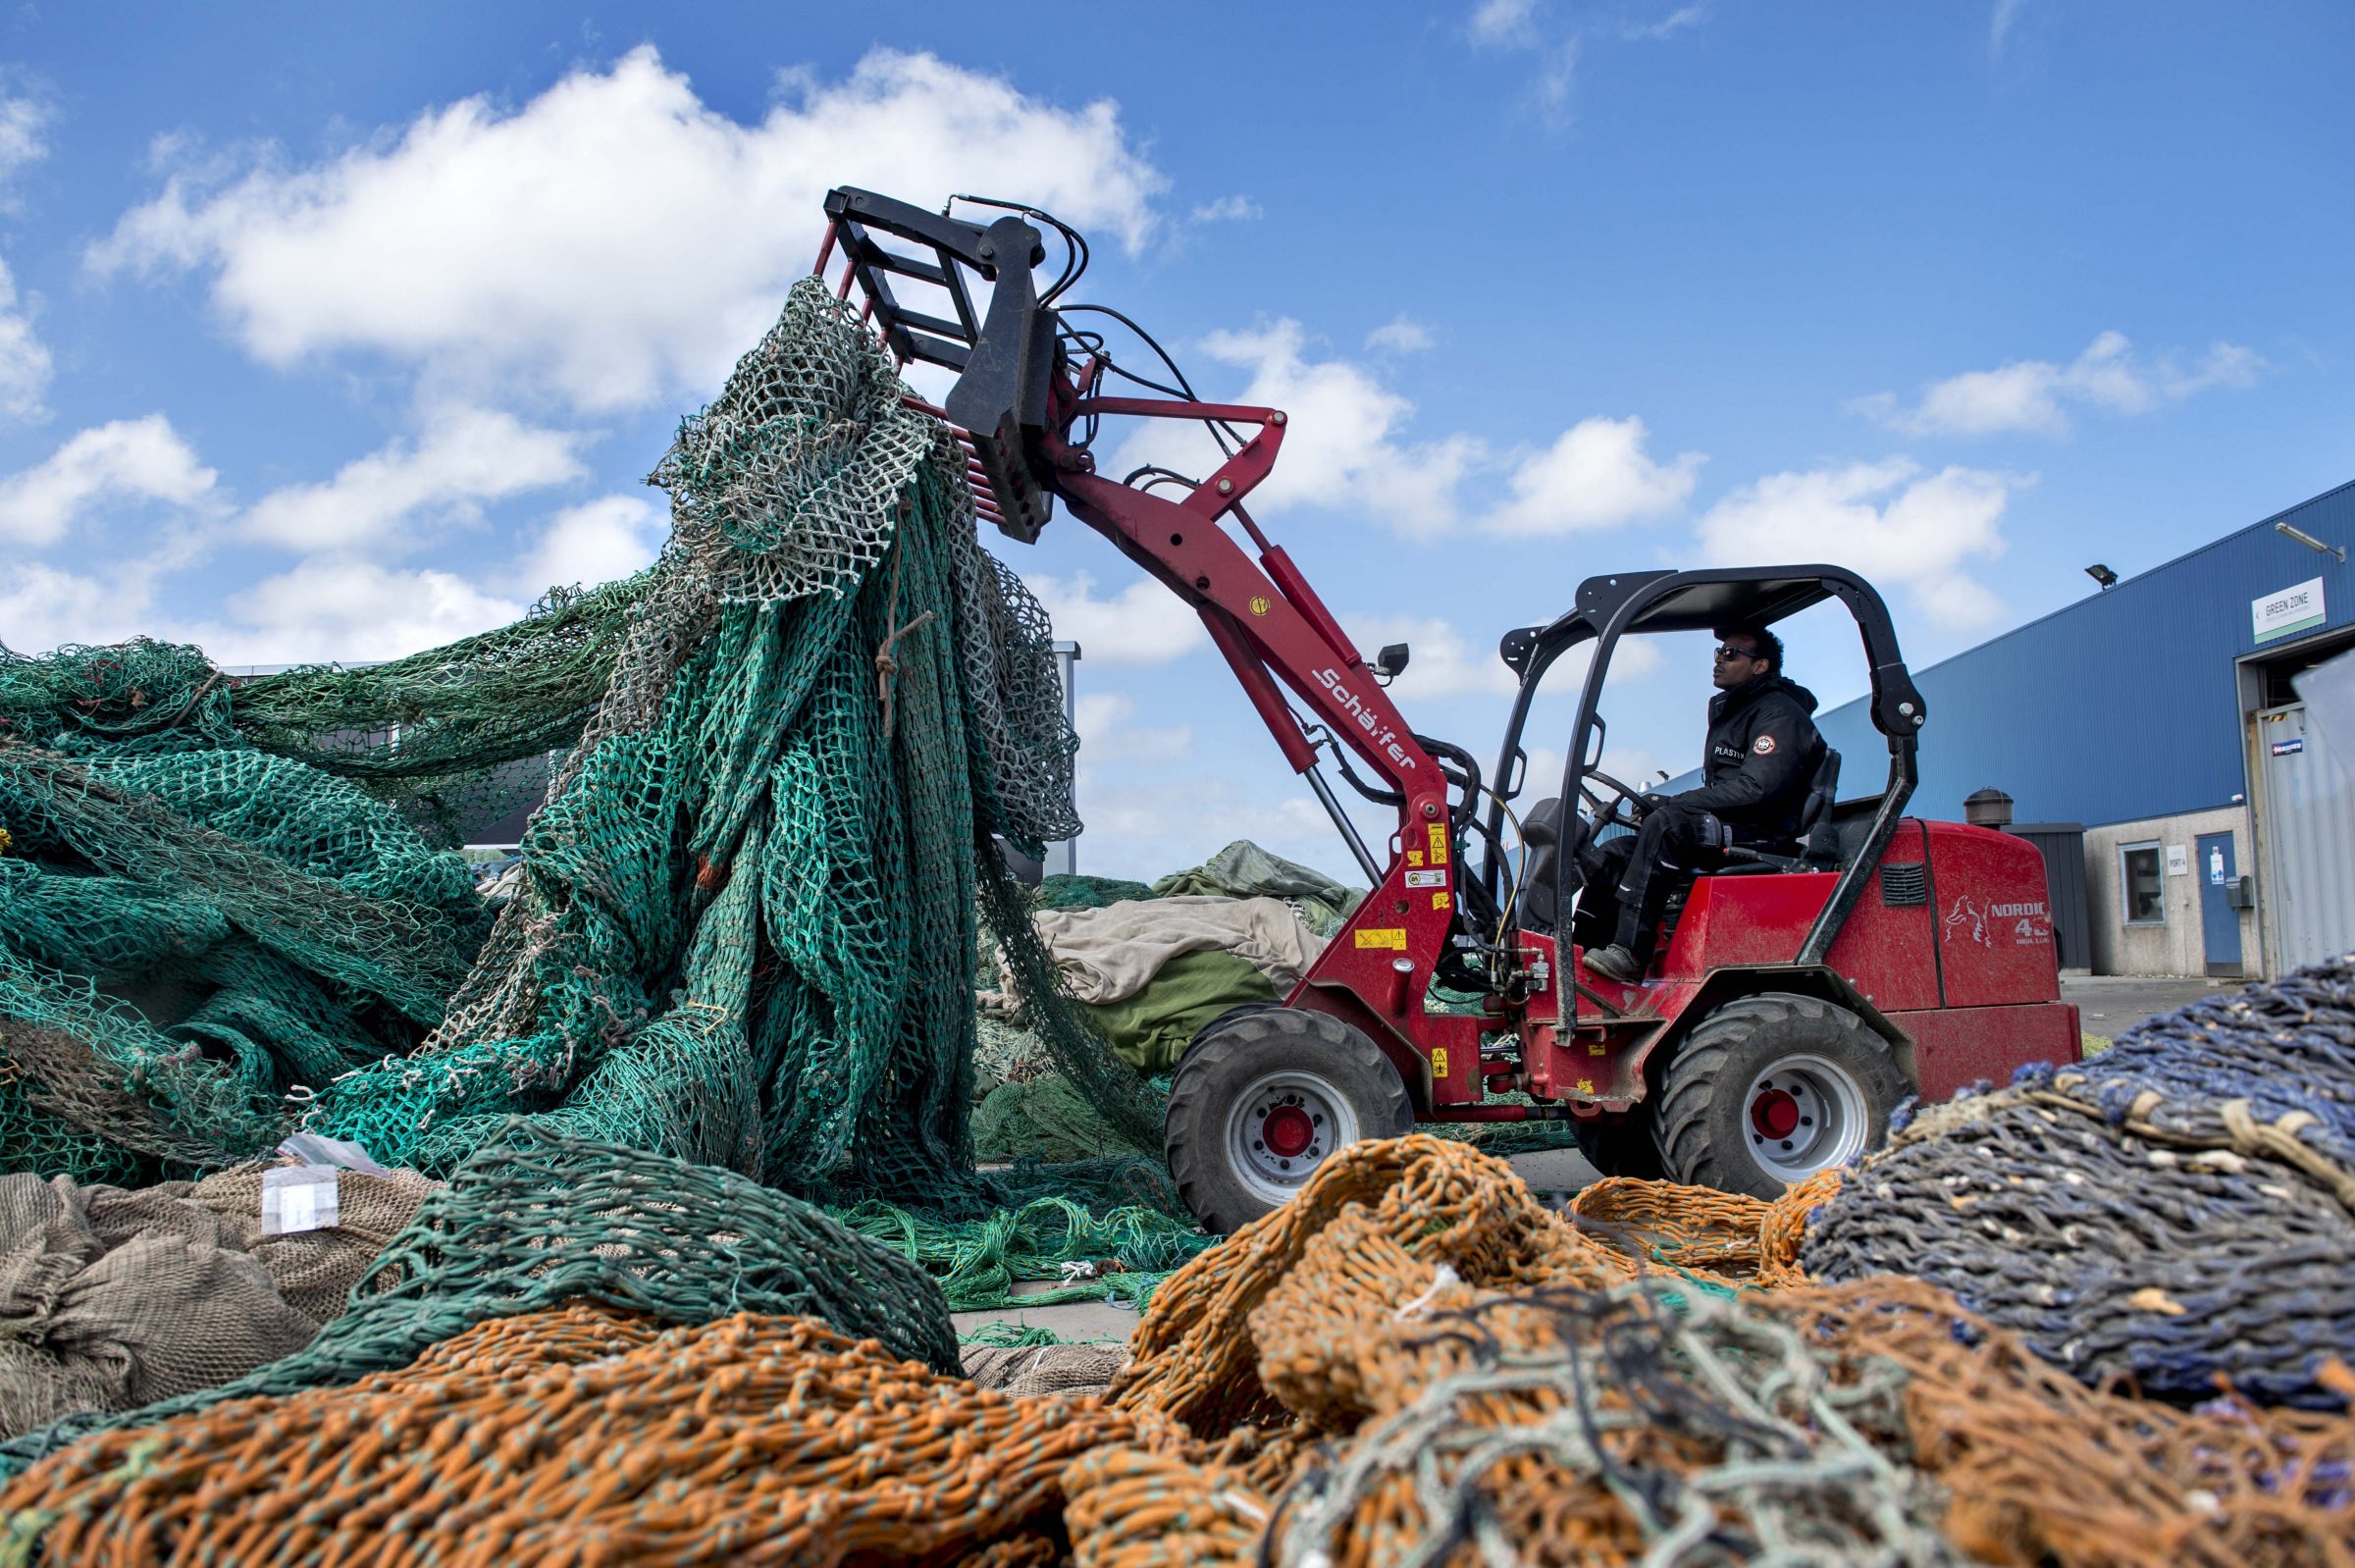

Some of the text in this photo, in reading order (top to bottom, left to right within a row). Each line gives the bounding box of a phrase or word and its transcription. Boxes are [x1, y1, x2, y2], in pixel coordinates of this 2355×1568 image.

[2266, 601, 2288, 617] GREEN
[2290, 592, 2309, 608] ZONE
[1991, 902, 2045, 917] NORDIC
